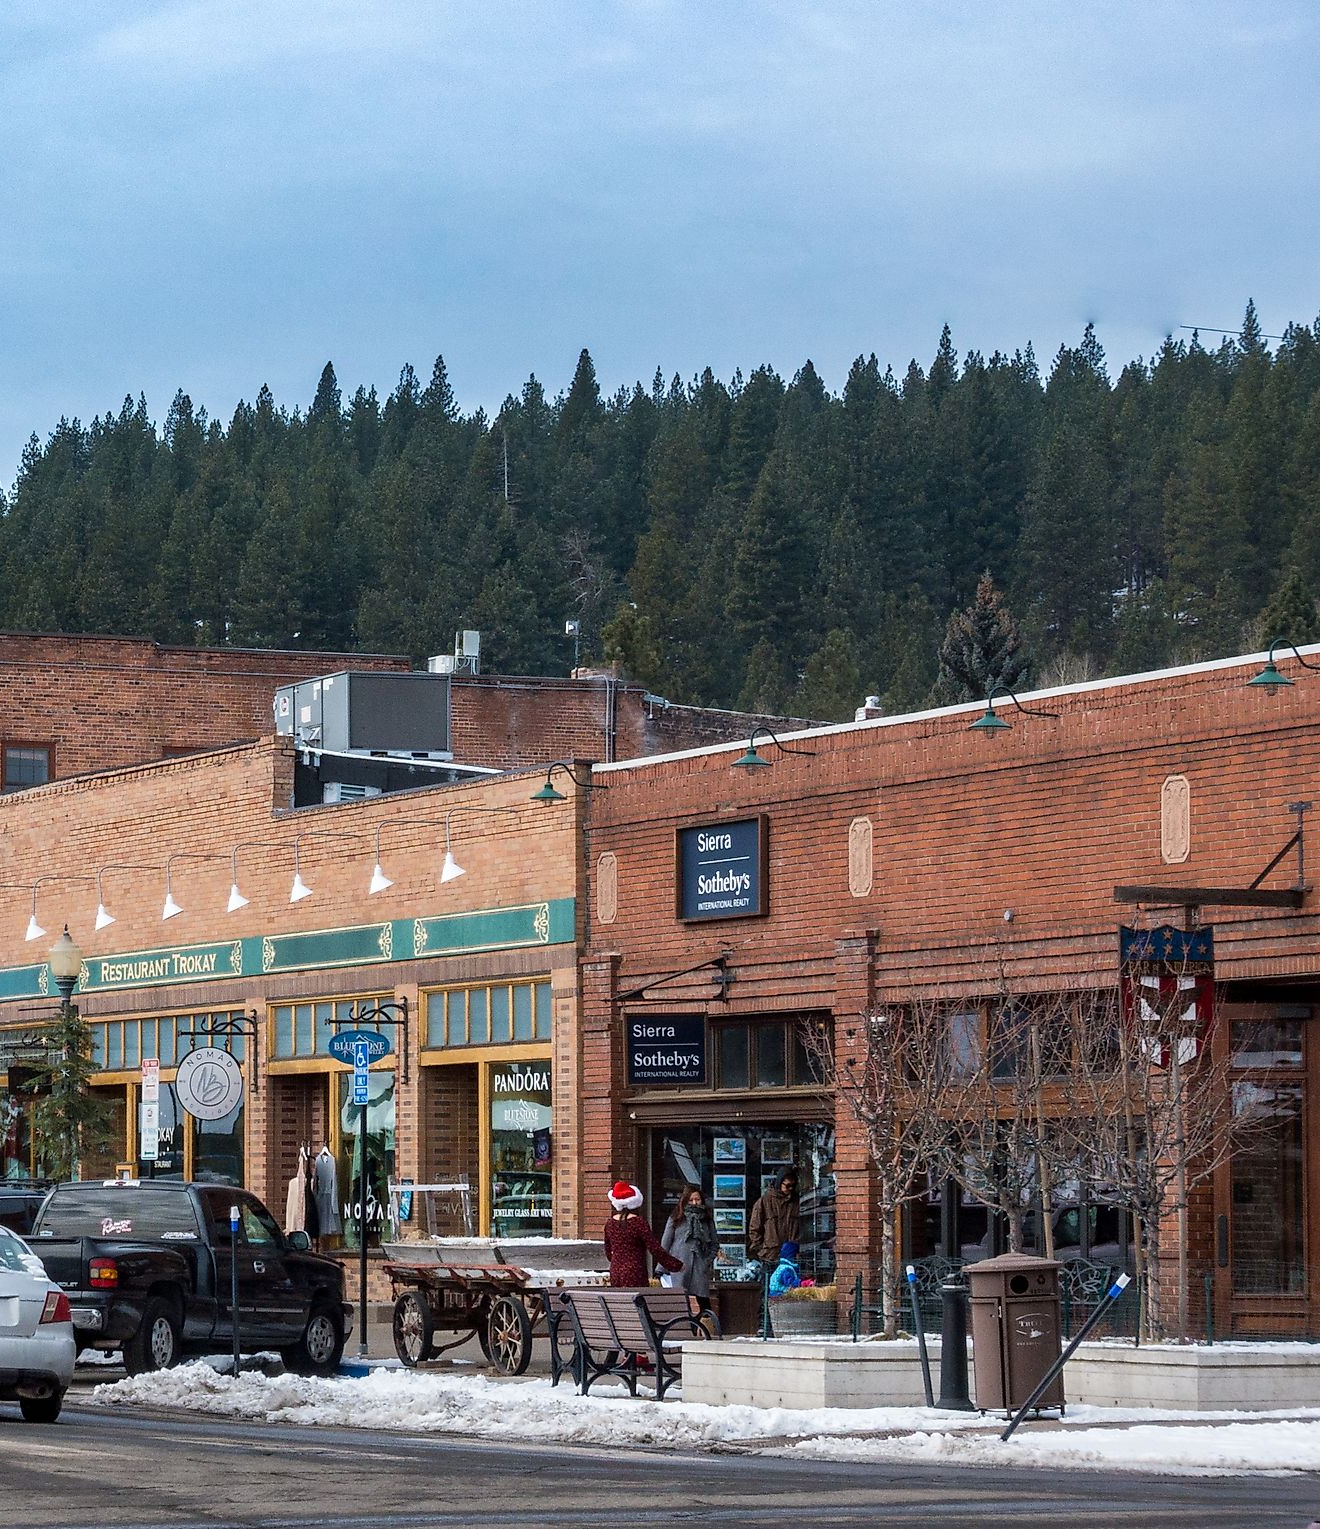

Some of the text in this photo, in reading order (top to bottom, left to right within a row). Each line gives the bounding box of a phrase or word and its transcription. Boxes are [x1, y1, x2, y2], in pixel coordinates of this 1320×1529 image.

[697, 832, 732, 852] Sierra
[697, 869, 750, 896] Sotheby's
[697, 897, 750, 911] INTERNATIONAL REALTY
[101, 953, 217, 982] RESTAURANT TROKAY
[632, 1024, 676, 1037] Sierra
[334, 1041, 385, 1052] BLUEONE
[186, 1051, 234, 1068] NOMAD
[634, 1051, 700, 1069] Sotheby's
[494, 1070, 549, 1093] PANDORA
[504, 1108, 539, 1121] BLUESTONE
[154, 1160, 172, 1168] STAURANT
[492, 1208, 515, 1219] JEWELRY
[515, 1208, 529, 1218] GLASS
